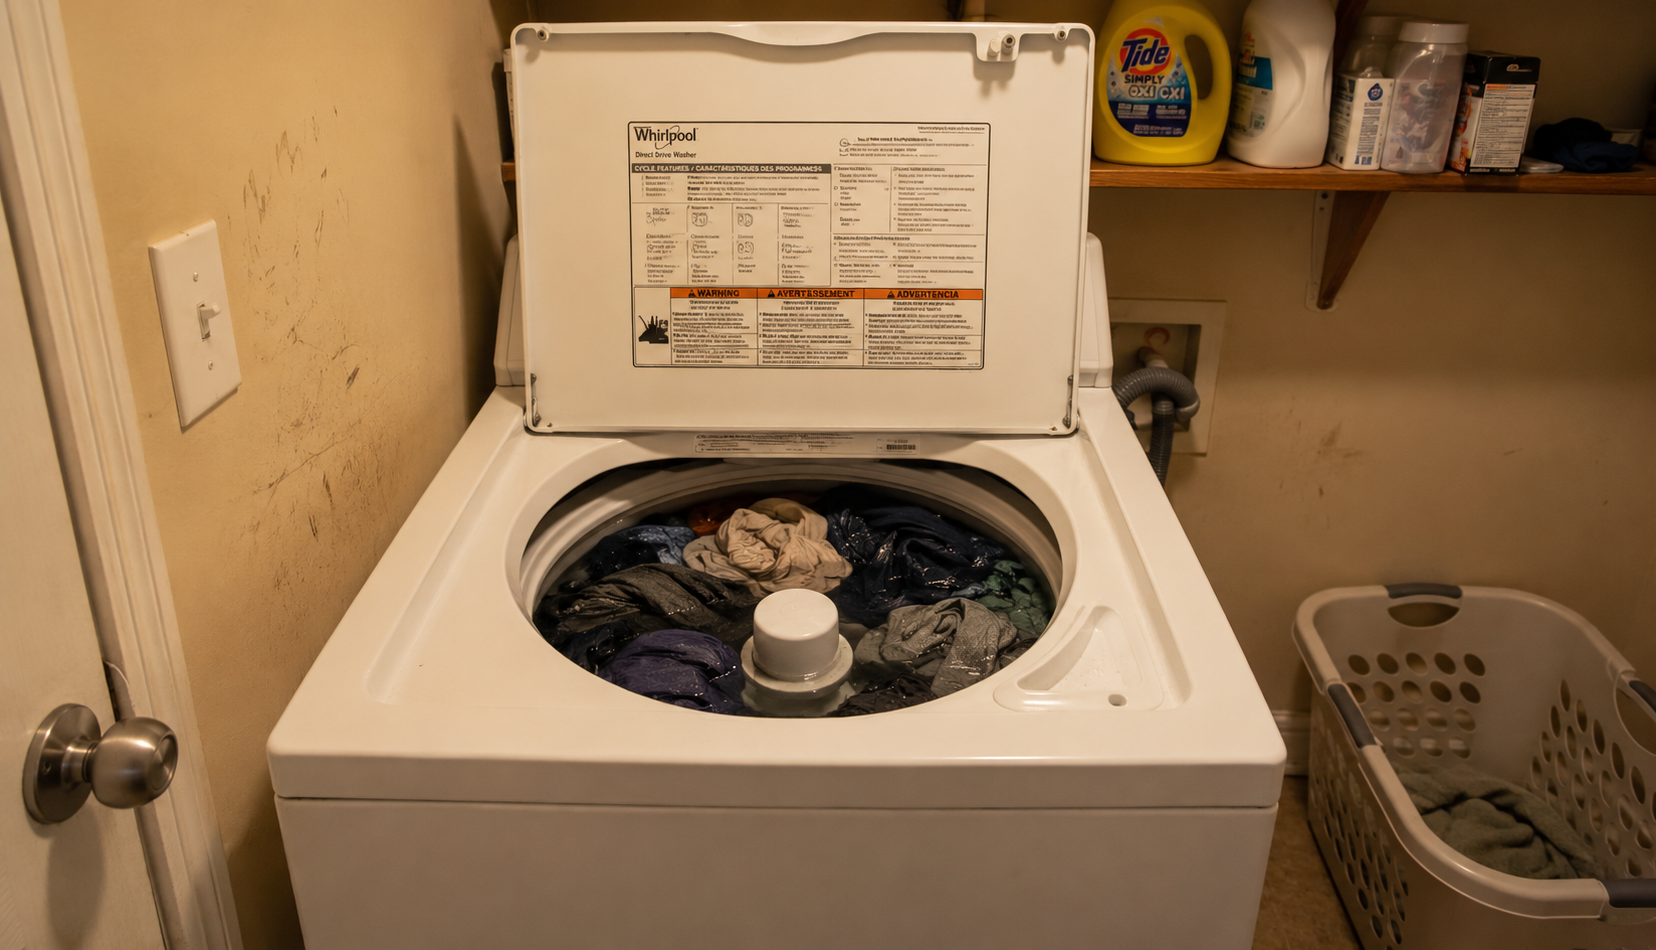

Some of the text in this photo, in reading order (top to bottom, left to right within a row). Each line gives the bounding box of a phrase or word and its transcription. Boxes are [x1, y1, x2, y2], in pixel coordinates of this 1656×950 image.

[1121, 37, 1171, 73] Tide
[1124, 74, 1165, 85] SIMPLY
[1128, 85, 1157, 99] OXI
[633, 125, 697, 150] Whirlpool
[697, 289, 740, 297] WARNING
[897, 290, 959, 299] ADVERTENCIA
